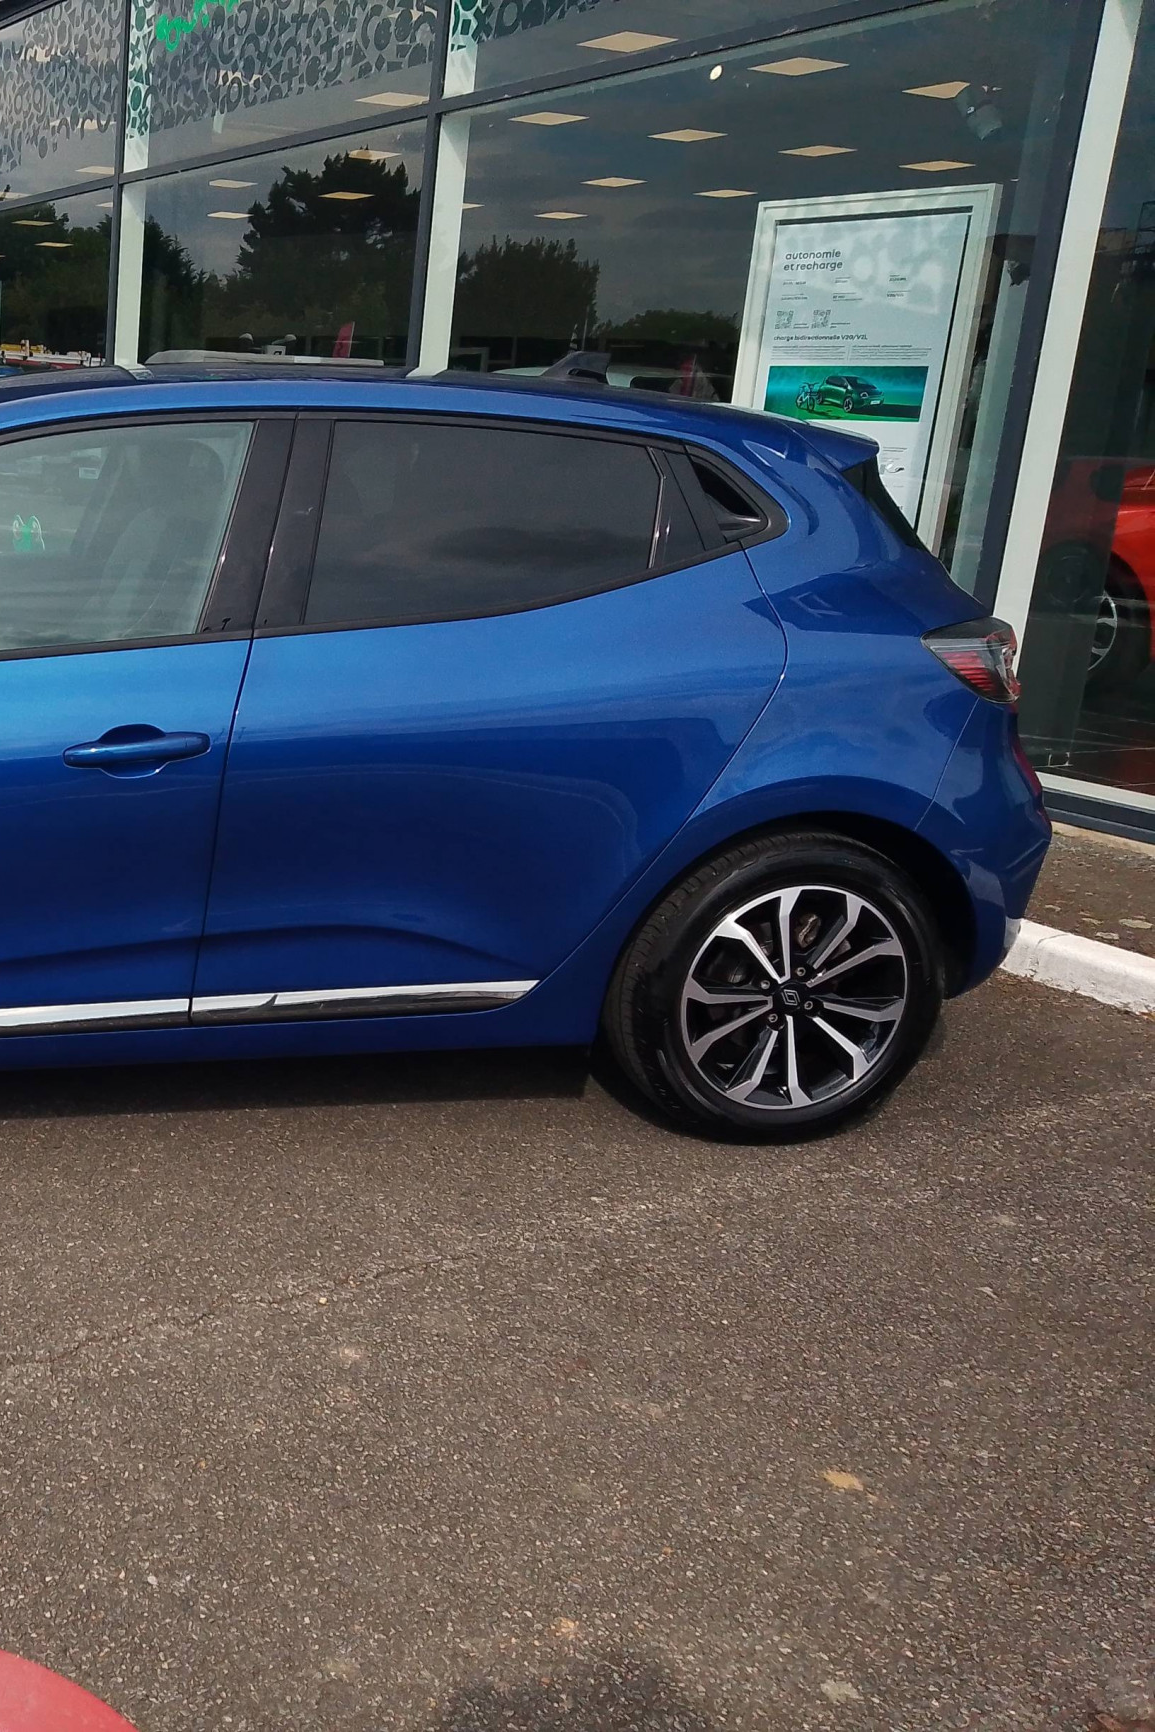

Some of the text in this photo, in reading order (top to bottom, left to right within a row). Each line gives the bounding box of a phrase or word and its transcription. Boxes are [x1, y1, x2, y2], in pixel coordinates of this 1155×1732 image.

[785, 249, 841, 260] autonomie
[783, 260, 843, 271] et recharge
